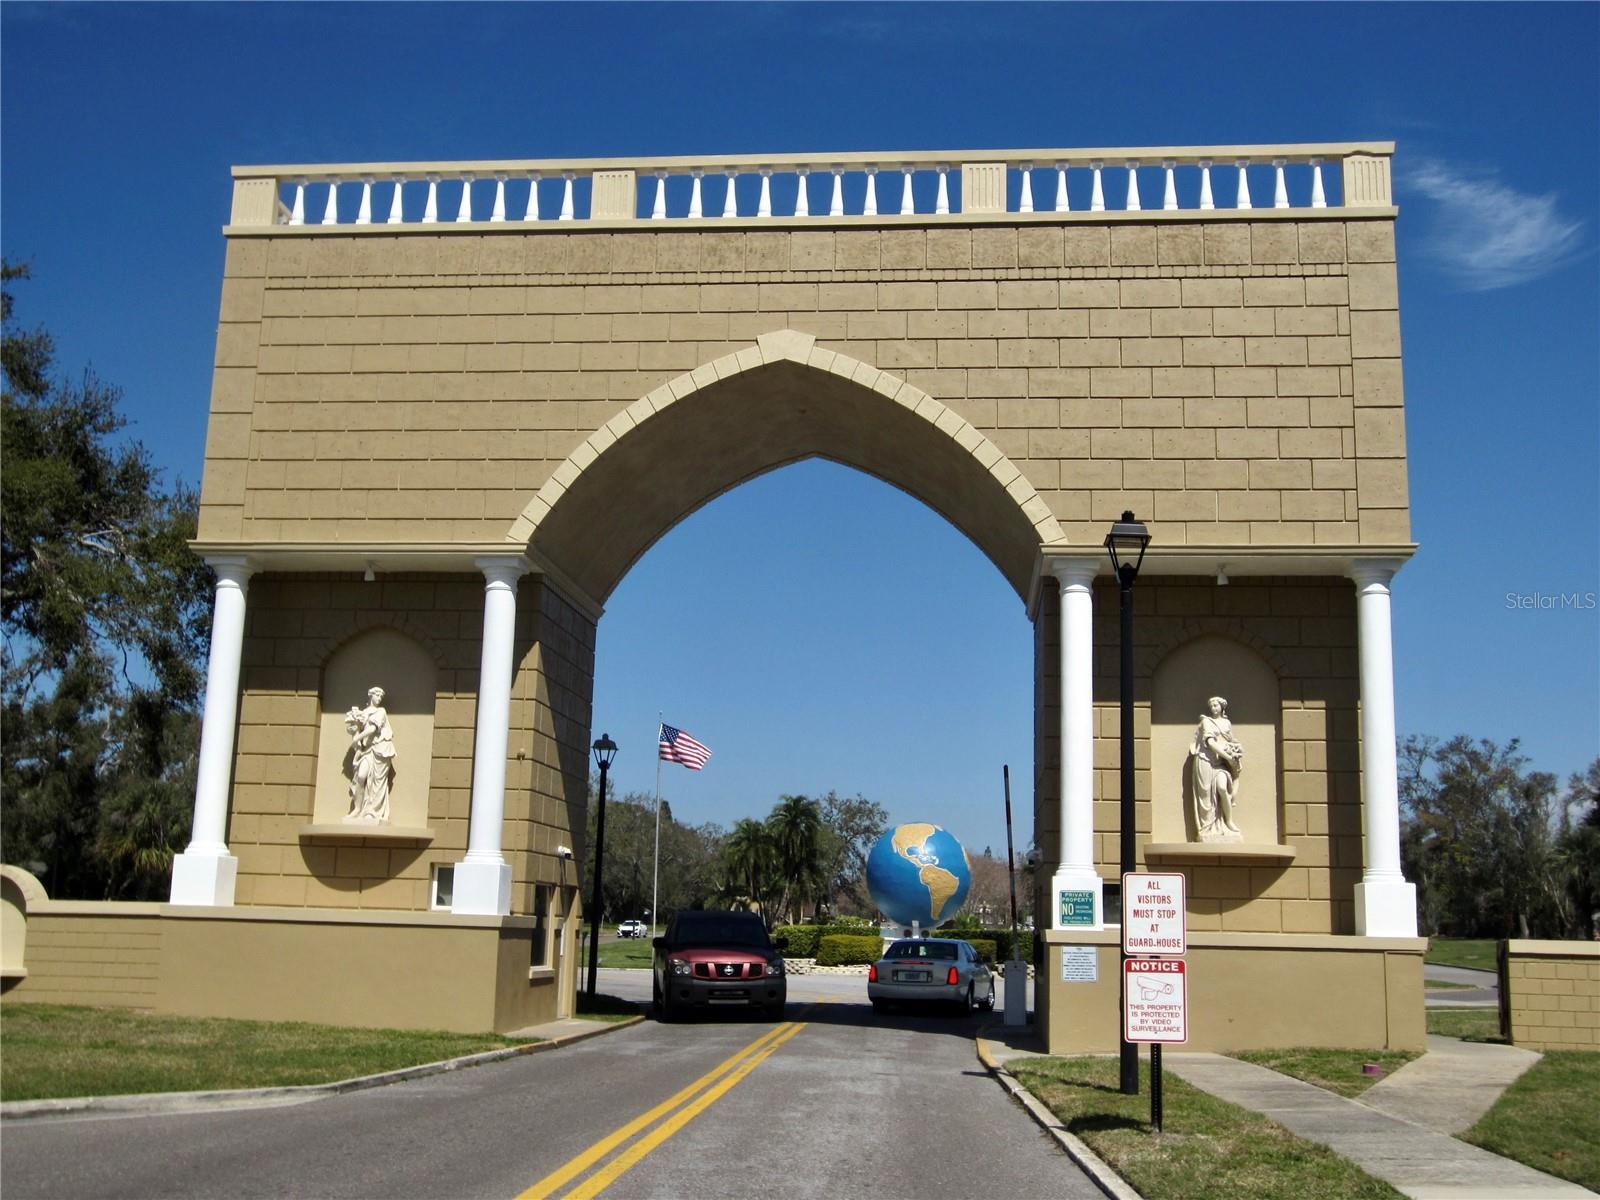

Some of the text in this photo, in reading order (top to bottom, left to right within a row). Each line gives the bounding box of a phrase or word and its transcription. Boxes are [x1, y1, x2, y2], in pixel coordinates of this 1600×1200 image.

[1147, 881, 1161, 890] ALL
[1137, 895, 1172, 904] VISITORS
[1062, 903, 1074, 916] NO
[1133, 909, 1176, 919] MUST STOP
[1150, 924, 1159, 933] AT
[1131, 962, 1179, 971] NOTICE
